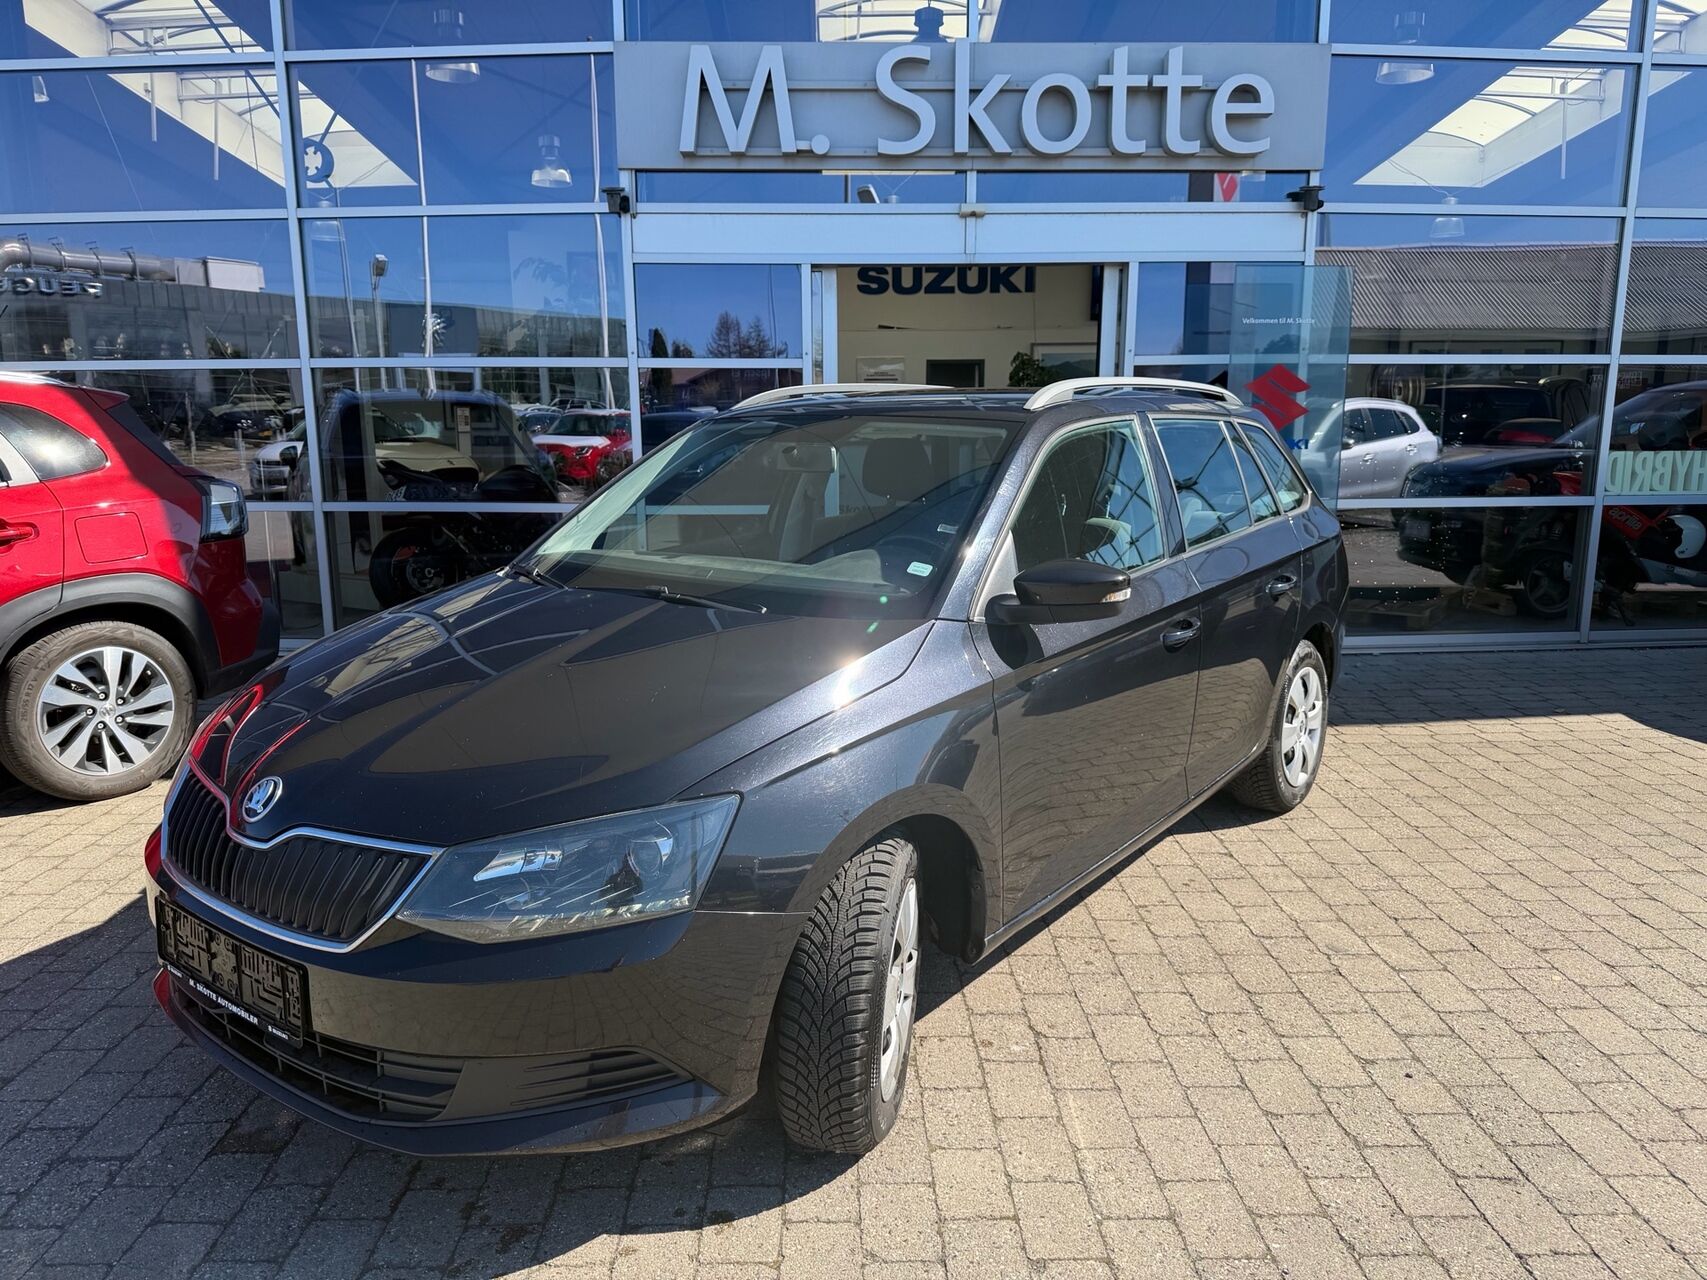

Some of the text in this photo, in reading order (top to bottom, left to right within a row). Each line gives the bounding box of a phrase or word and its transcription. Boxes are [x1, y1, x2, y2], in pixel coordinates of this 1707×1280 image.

[679, 40, 1276, 157] M. Skotte
[857, 265, 1036, 295] SUZUKI
[1241, 317, 1278, 325] Velkommen
[1295, 317, 1315, 325] Skotte
[1608, 507, 1642, 531] aprilia
[196, 983, 217, 1001] SKOTTE
[217, 995, 259, 1026] AUTOMOBILER
